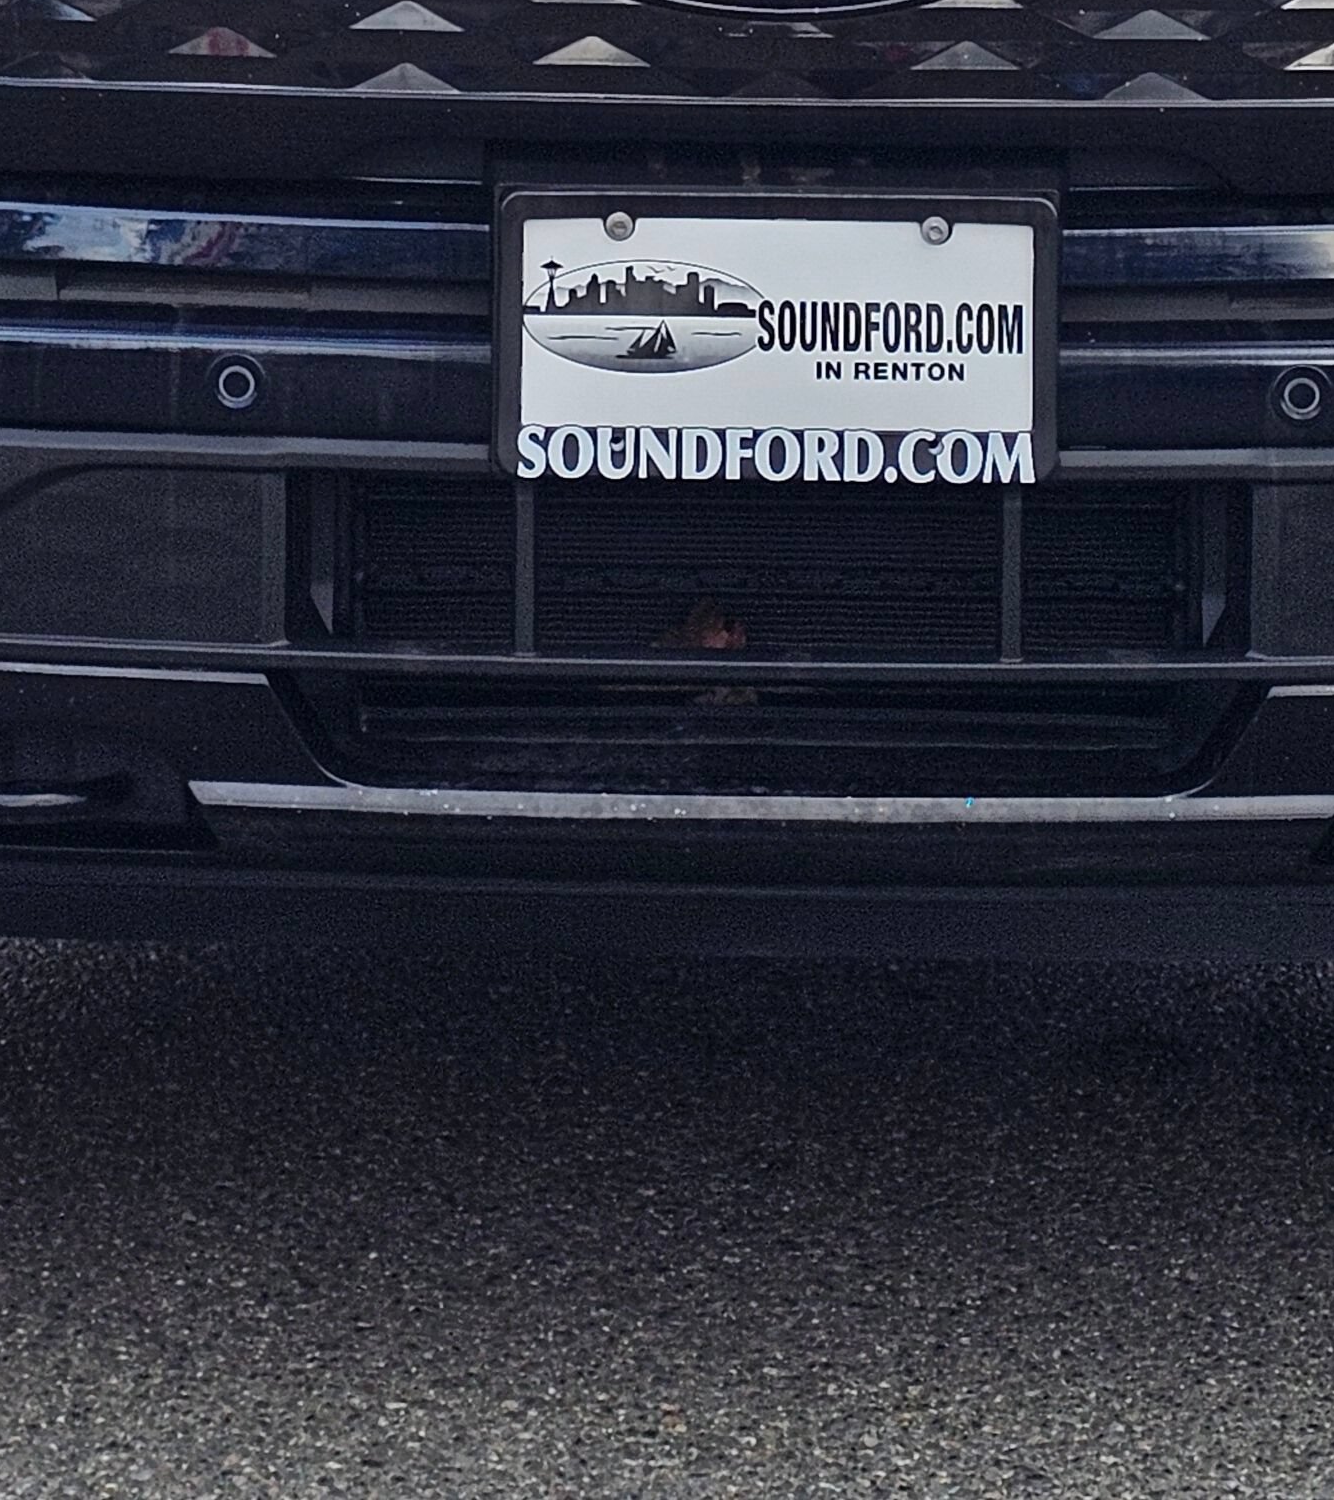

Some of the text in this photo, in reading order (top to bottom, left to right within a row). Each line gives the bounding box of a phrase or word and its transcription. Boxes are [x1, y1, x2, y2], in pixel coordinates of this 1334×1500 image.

[757, 300, 1024, 354] SOUNDFORD.COM
[816, 361, 965, 381] IN RENTON
[516, 426, 1036, 484] SOUNDFORD.COM
